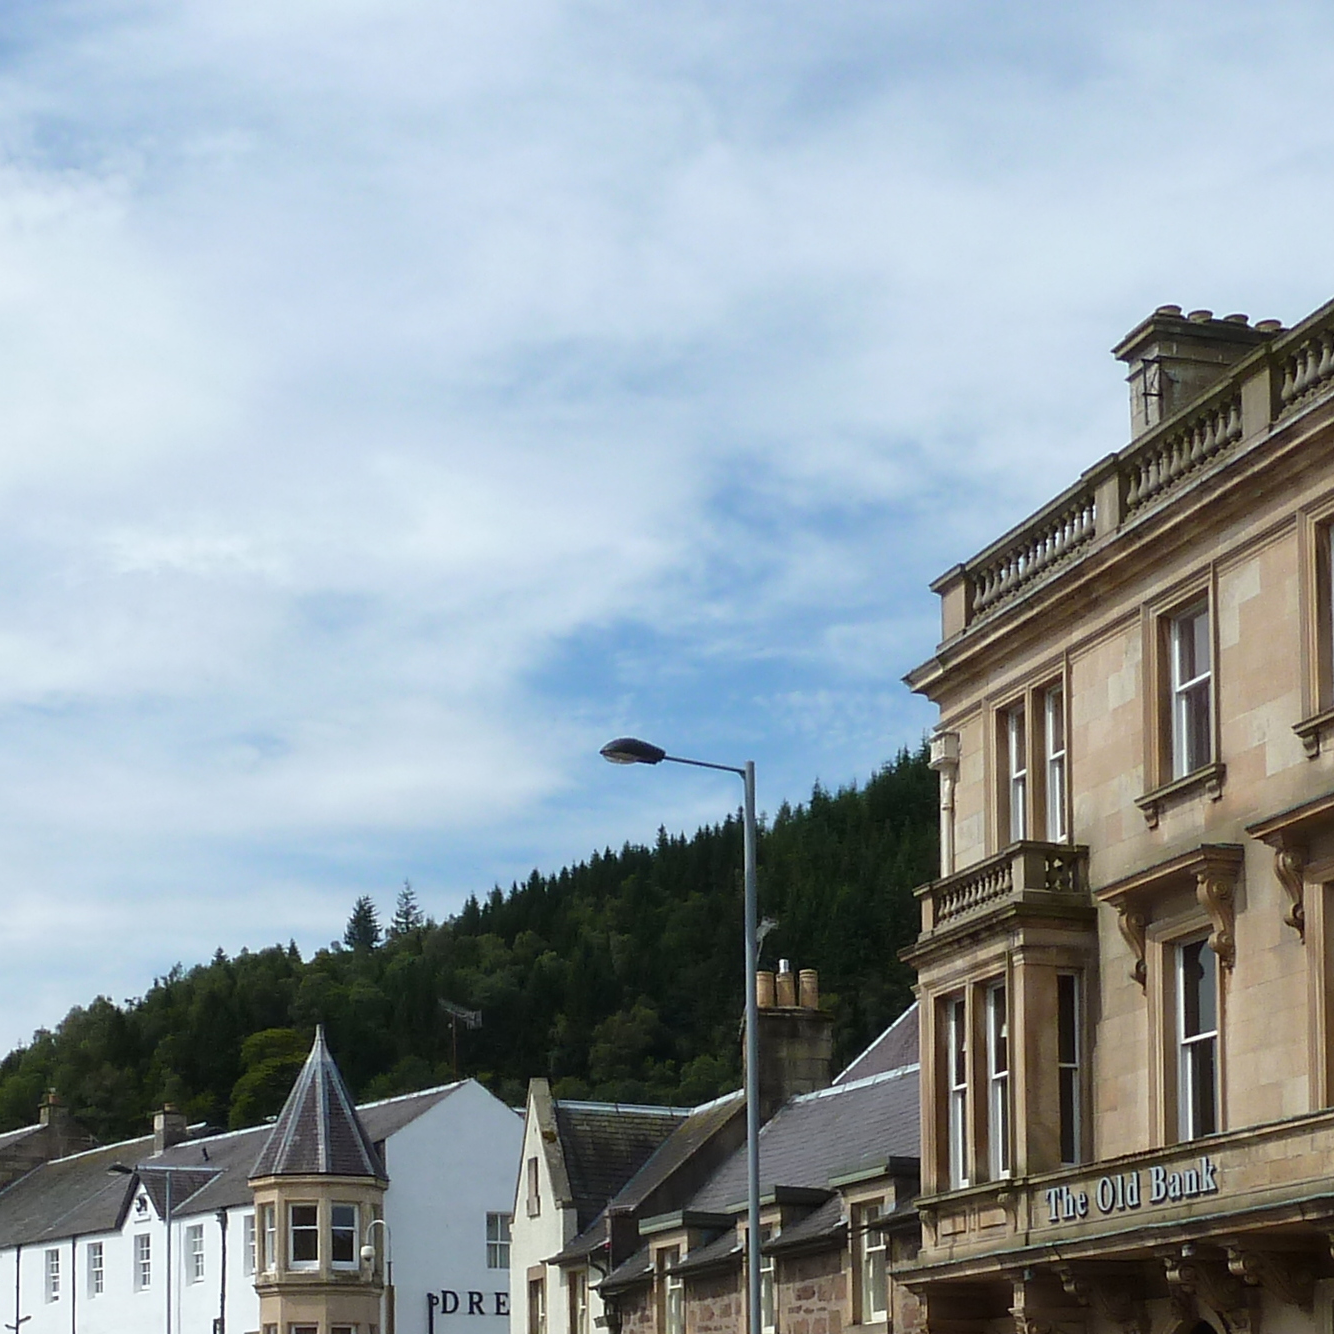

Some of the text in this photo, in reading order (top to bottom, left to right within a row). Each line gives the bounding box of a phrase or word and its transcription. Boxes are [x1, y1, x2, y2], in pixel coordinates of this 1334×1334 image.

[1047, 1156, 1217, 1221] The Old Bank
